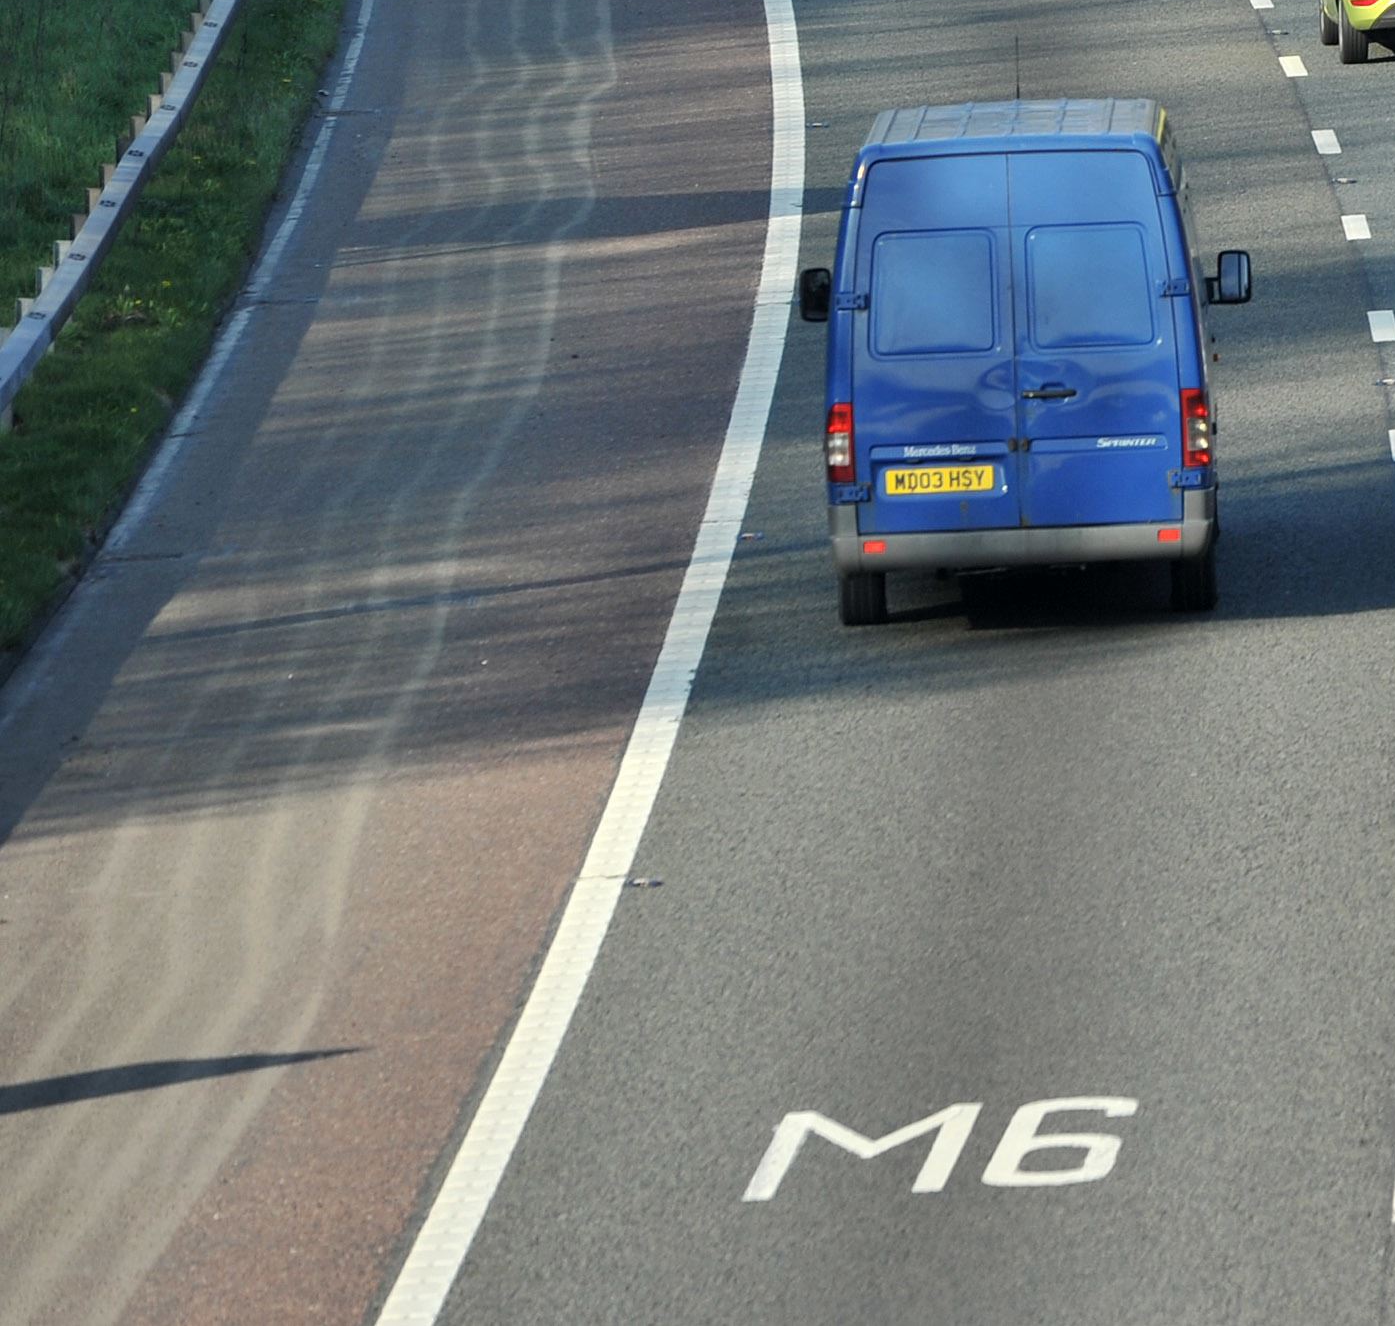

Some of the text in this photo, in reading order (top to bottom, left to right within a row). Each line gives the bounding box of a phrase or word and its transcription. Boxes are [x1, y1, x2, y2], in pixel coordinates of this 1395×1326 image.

[894, 469, 985, 491] MD03 HSY
[741, 1095, 1140, 1202] M6
